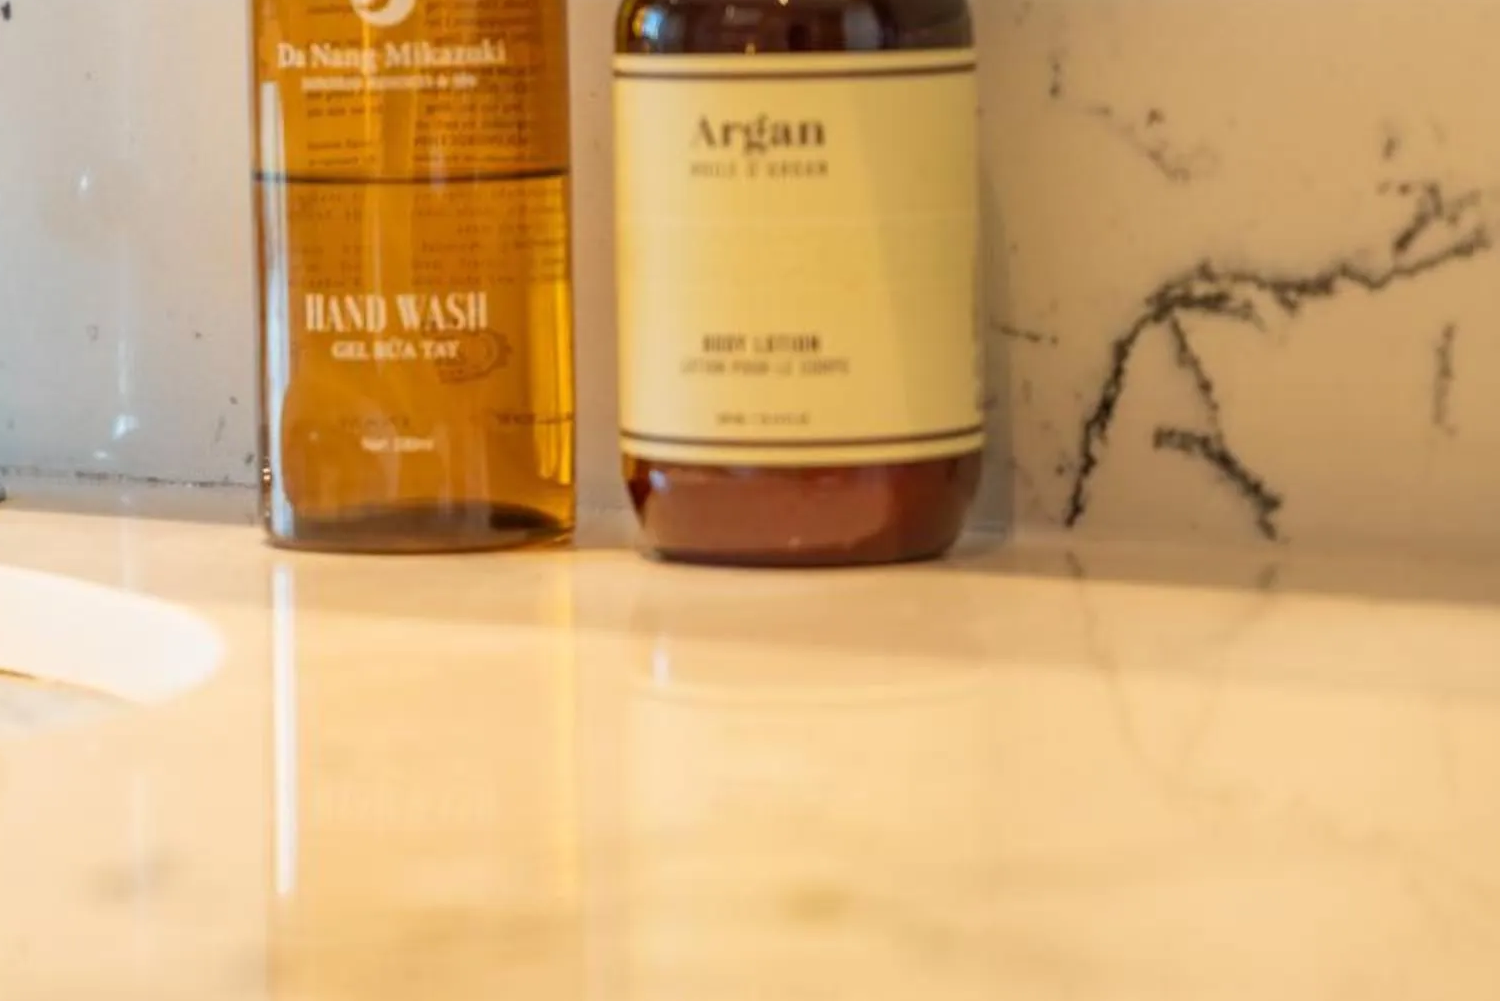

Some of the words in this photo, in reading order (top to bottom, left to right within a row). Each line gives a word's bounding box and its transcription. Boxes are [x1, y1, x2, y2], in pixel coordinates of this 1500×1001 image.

[277, 42, 306, 69] Da
[310, 42, 378, 74] Nang
[385, 38, 506, 68] Mikazuki
[690, 114, 827, 155] Argan
[305, 293, 388, 333] HAND
[396, 291, 489, 332] WASH
